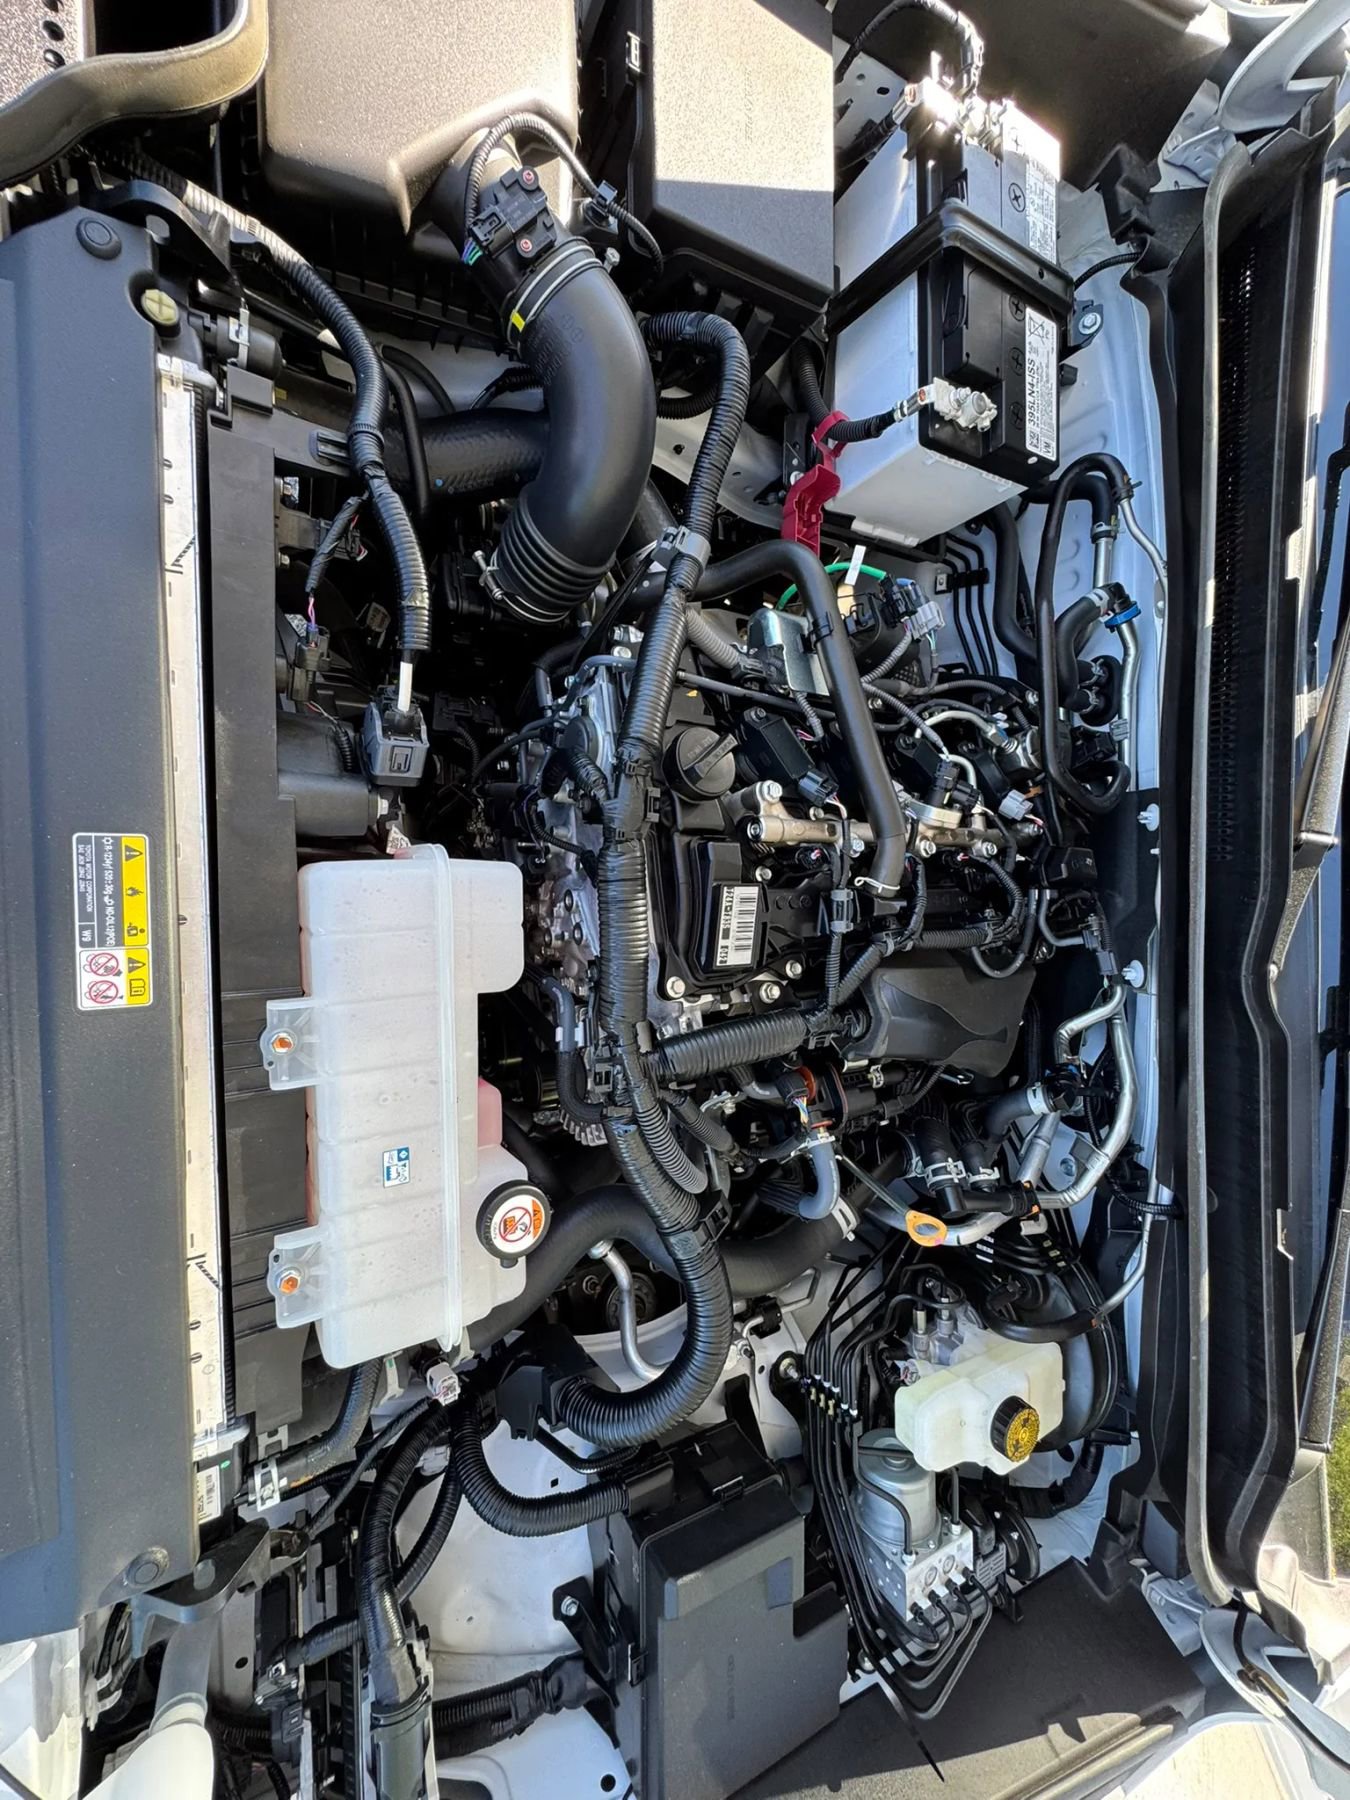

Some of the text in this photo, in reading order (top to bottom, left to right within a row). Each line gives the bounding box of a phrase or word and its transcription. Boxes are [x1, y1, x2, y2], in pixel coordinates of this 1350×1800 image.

[1028, 359, 1036, 426] 395LN4-ISS
[102, 846, 113, 870] R-1234yf
[82, 930, 92, 942] W9
